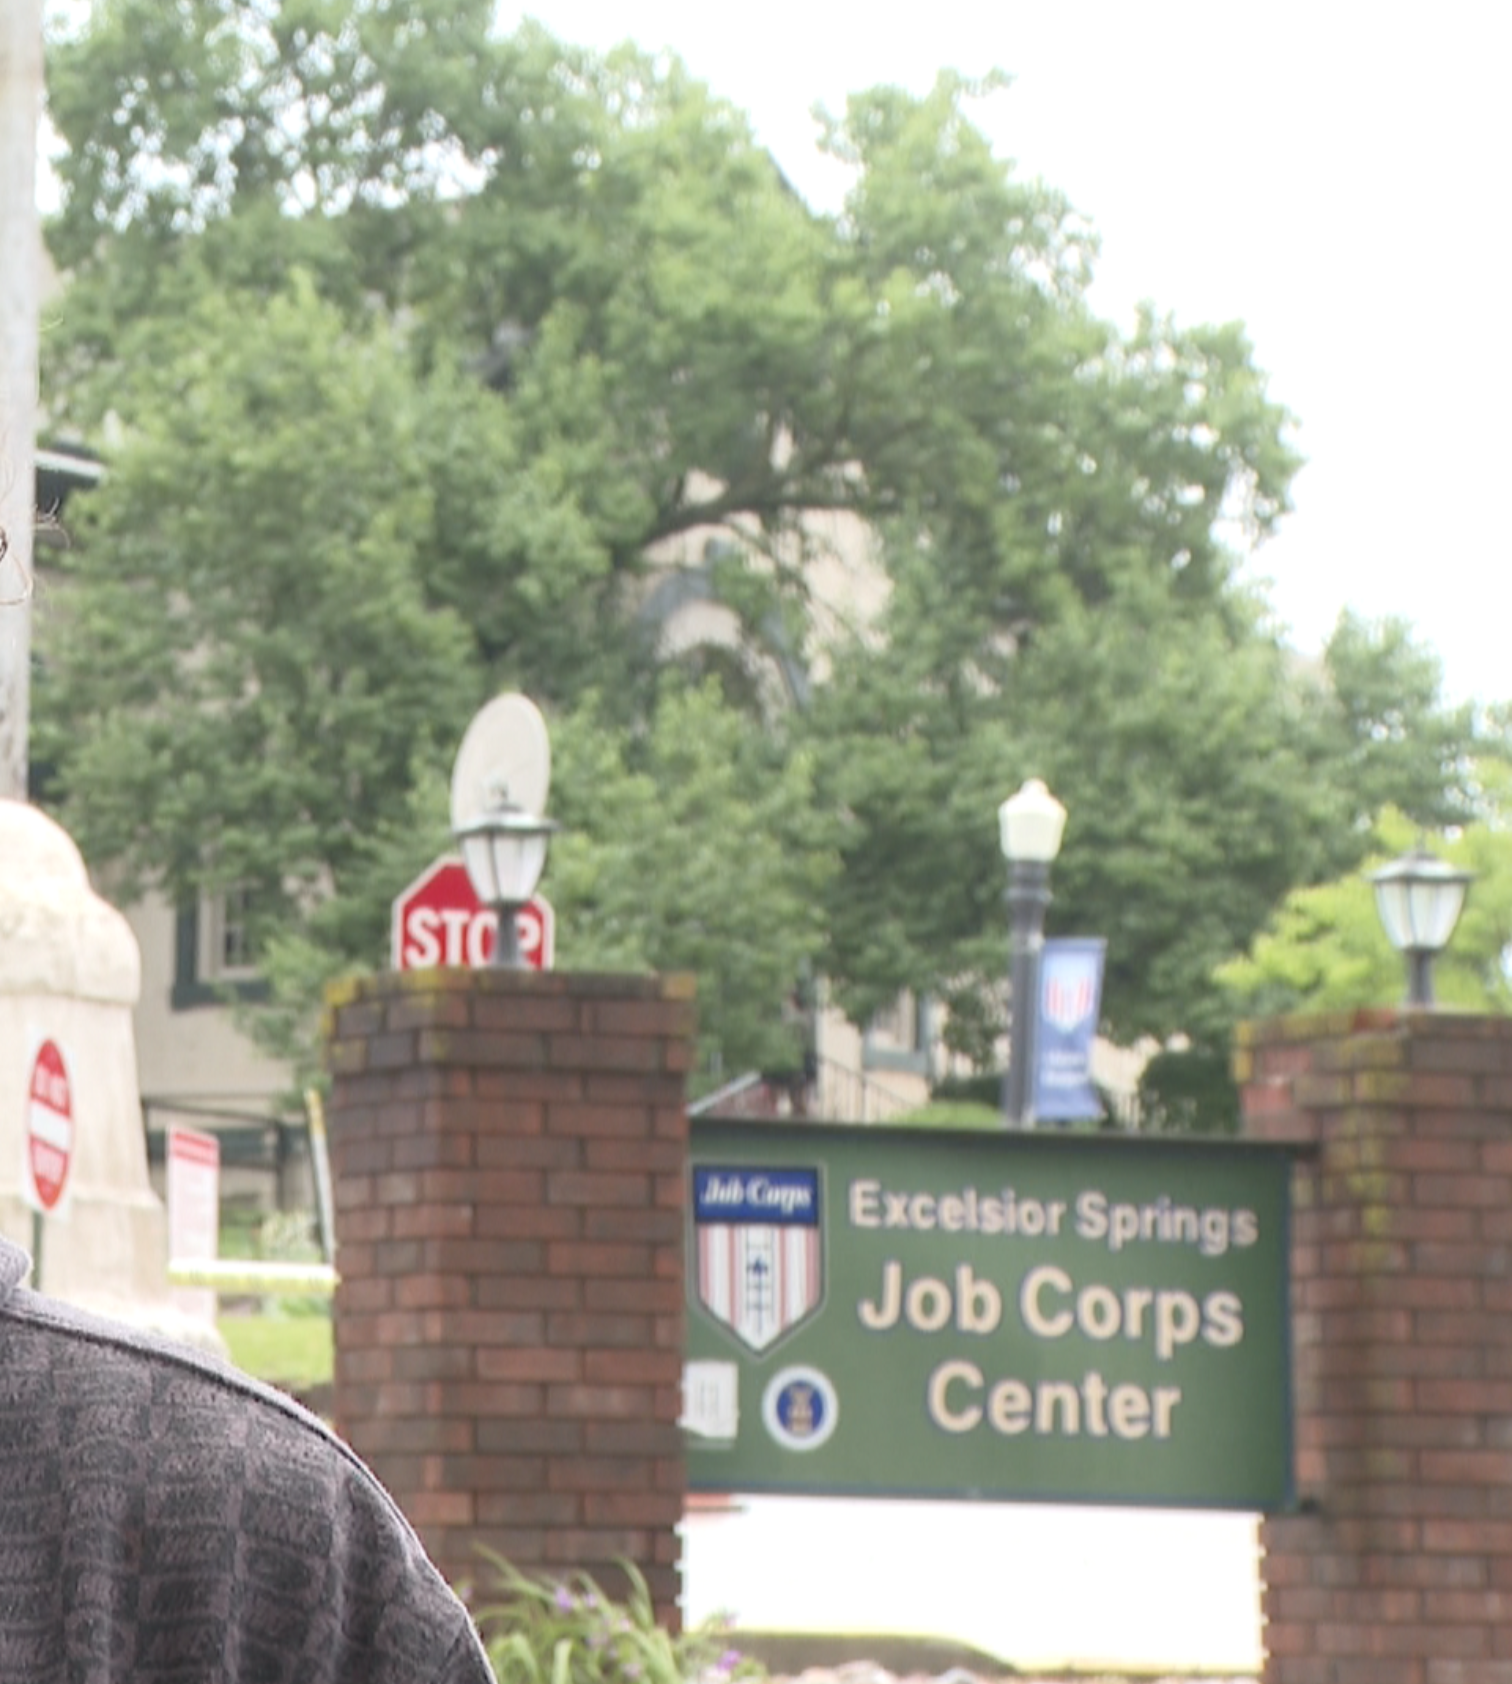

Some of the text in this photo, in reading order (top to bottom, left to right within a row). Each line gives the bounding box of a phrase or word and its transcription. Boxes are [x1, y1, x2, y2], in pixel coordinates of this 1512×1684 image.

[405, 908, 541, 967] STOP
[699, 1176, 812, 1215] Job Corps
[849, 1179, 1259, 1256] Excelsior Springs
[857, 1260, 1244, 1361] Job Corps
[928, 1359, 1181, 1439] Center
